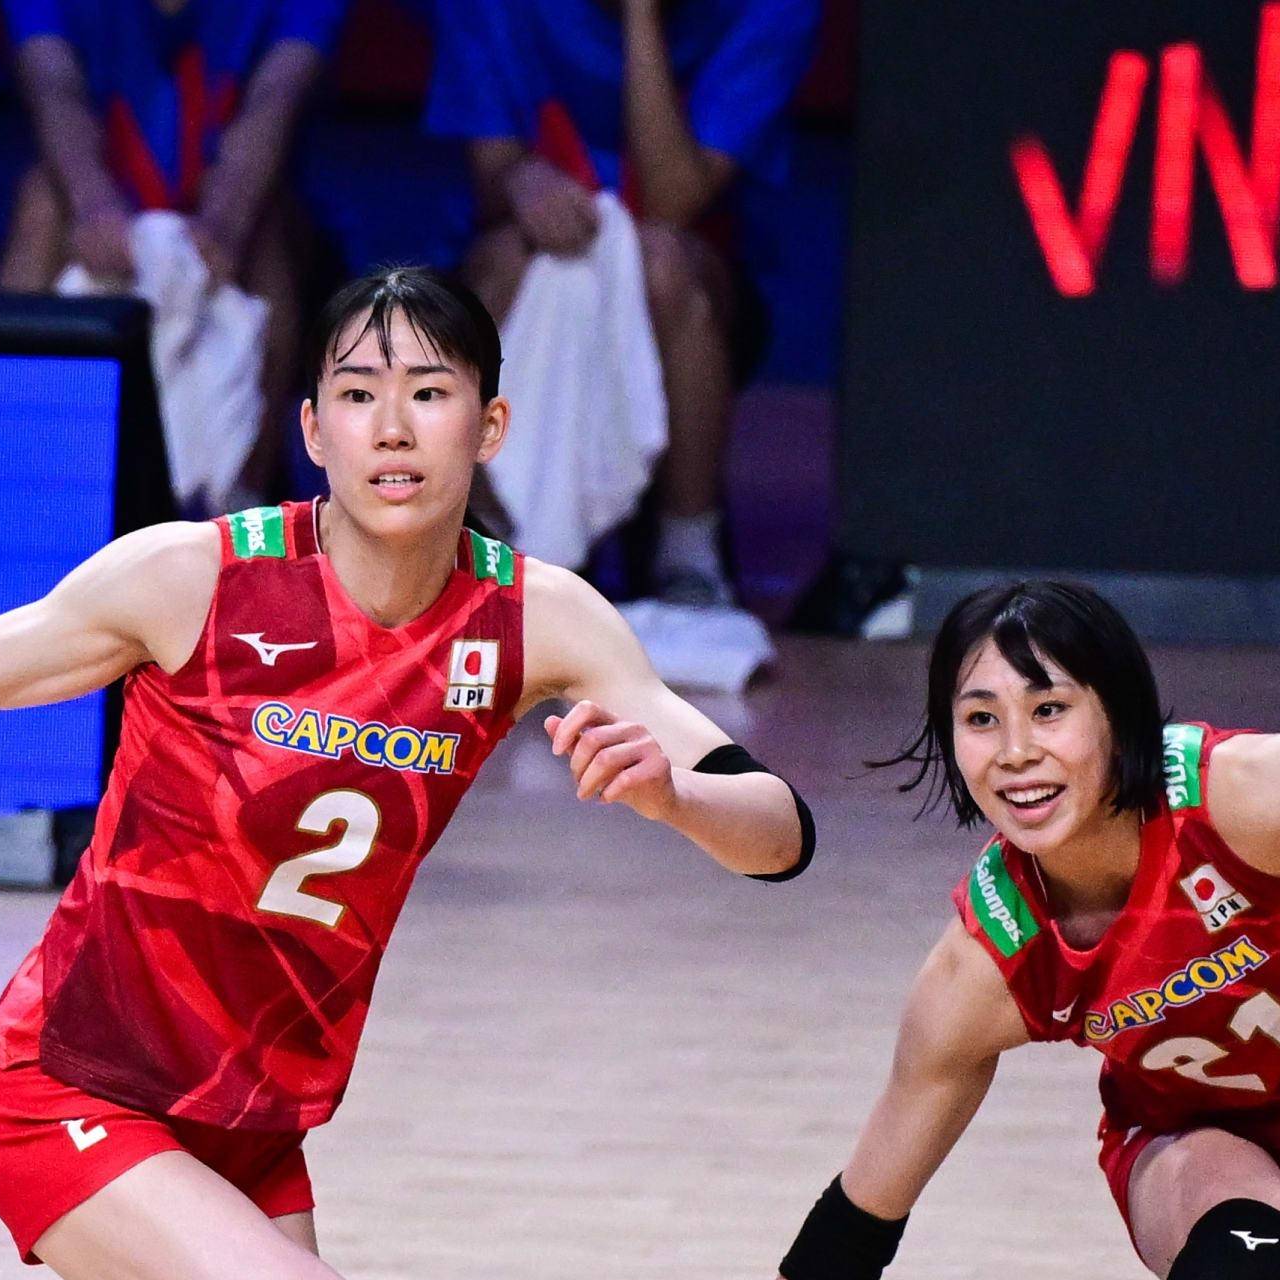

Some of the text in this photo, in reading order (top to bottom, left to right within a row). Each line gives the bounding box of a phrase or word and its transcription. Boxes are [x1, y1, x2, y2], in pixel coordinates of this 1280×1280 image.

[252, 701, 460, 774] CAPCOM
[255, 788, 382, 928] 2
[1210, 898, 1242, 929] JPN
[1083, 935, 1269, 1041] CAPCOM
